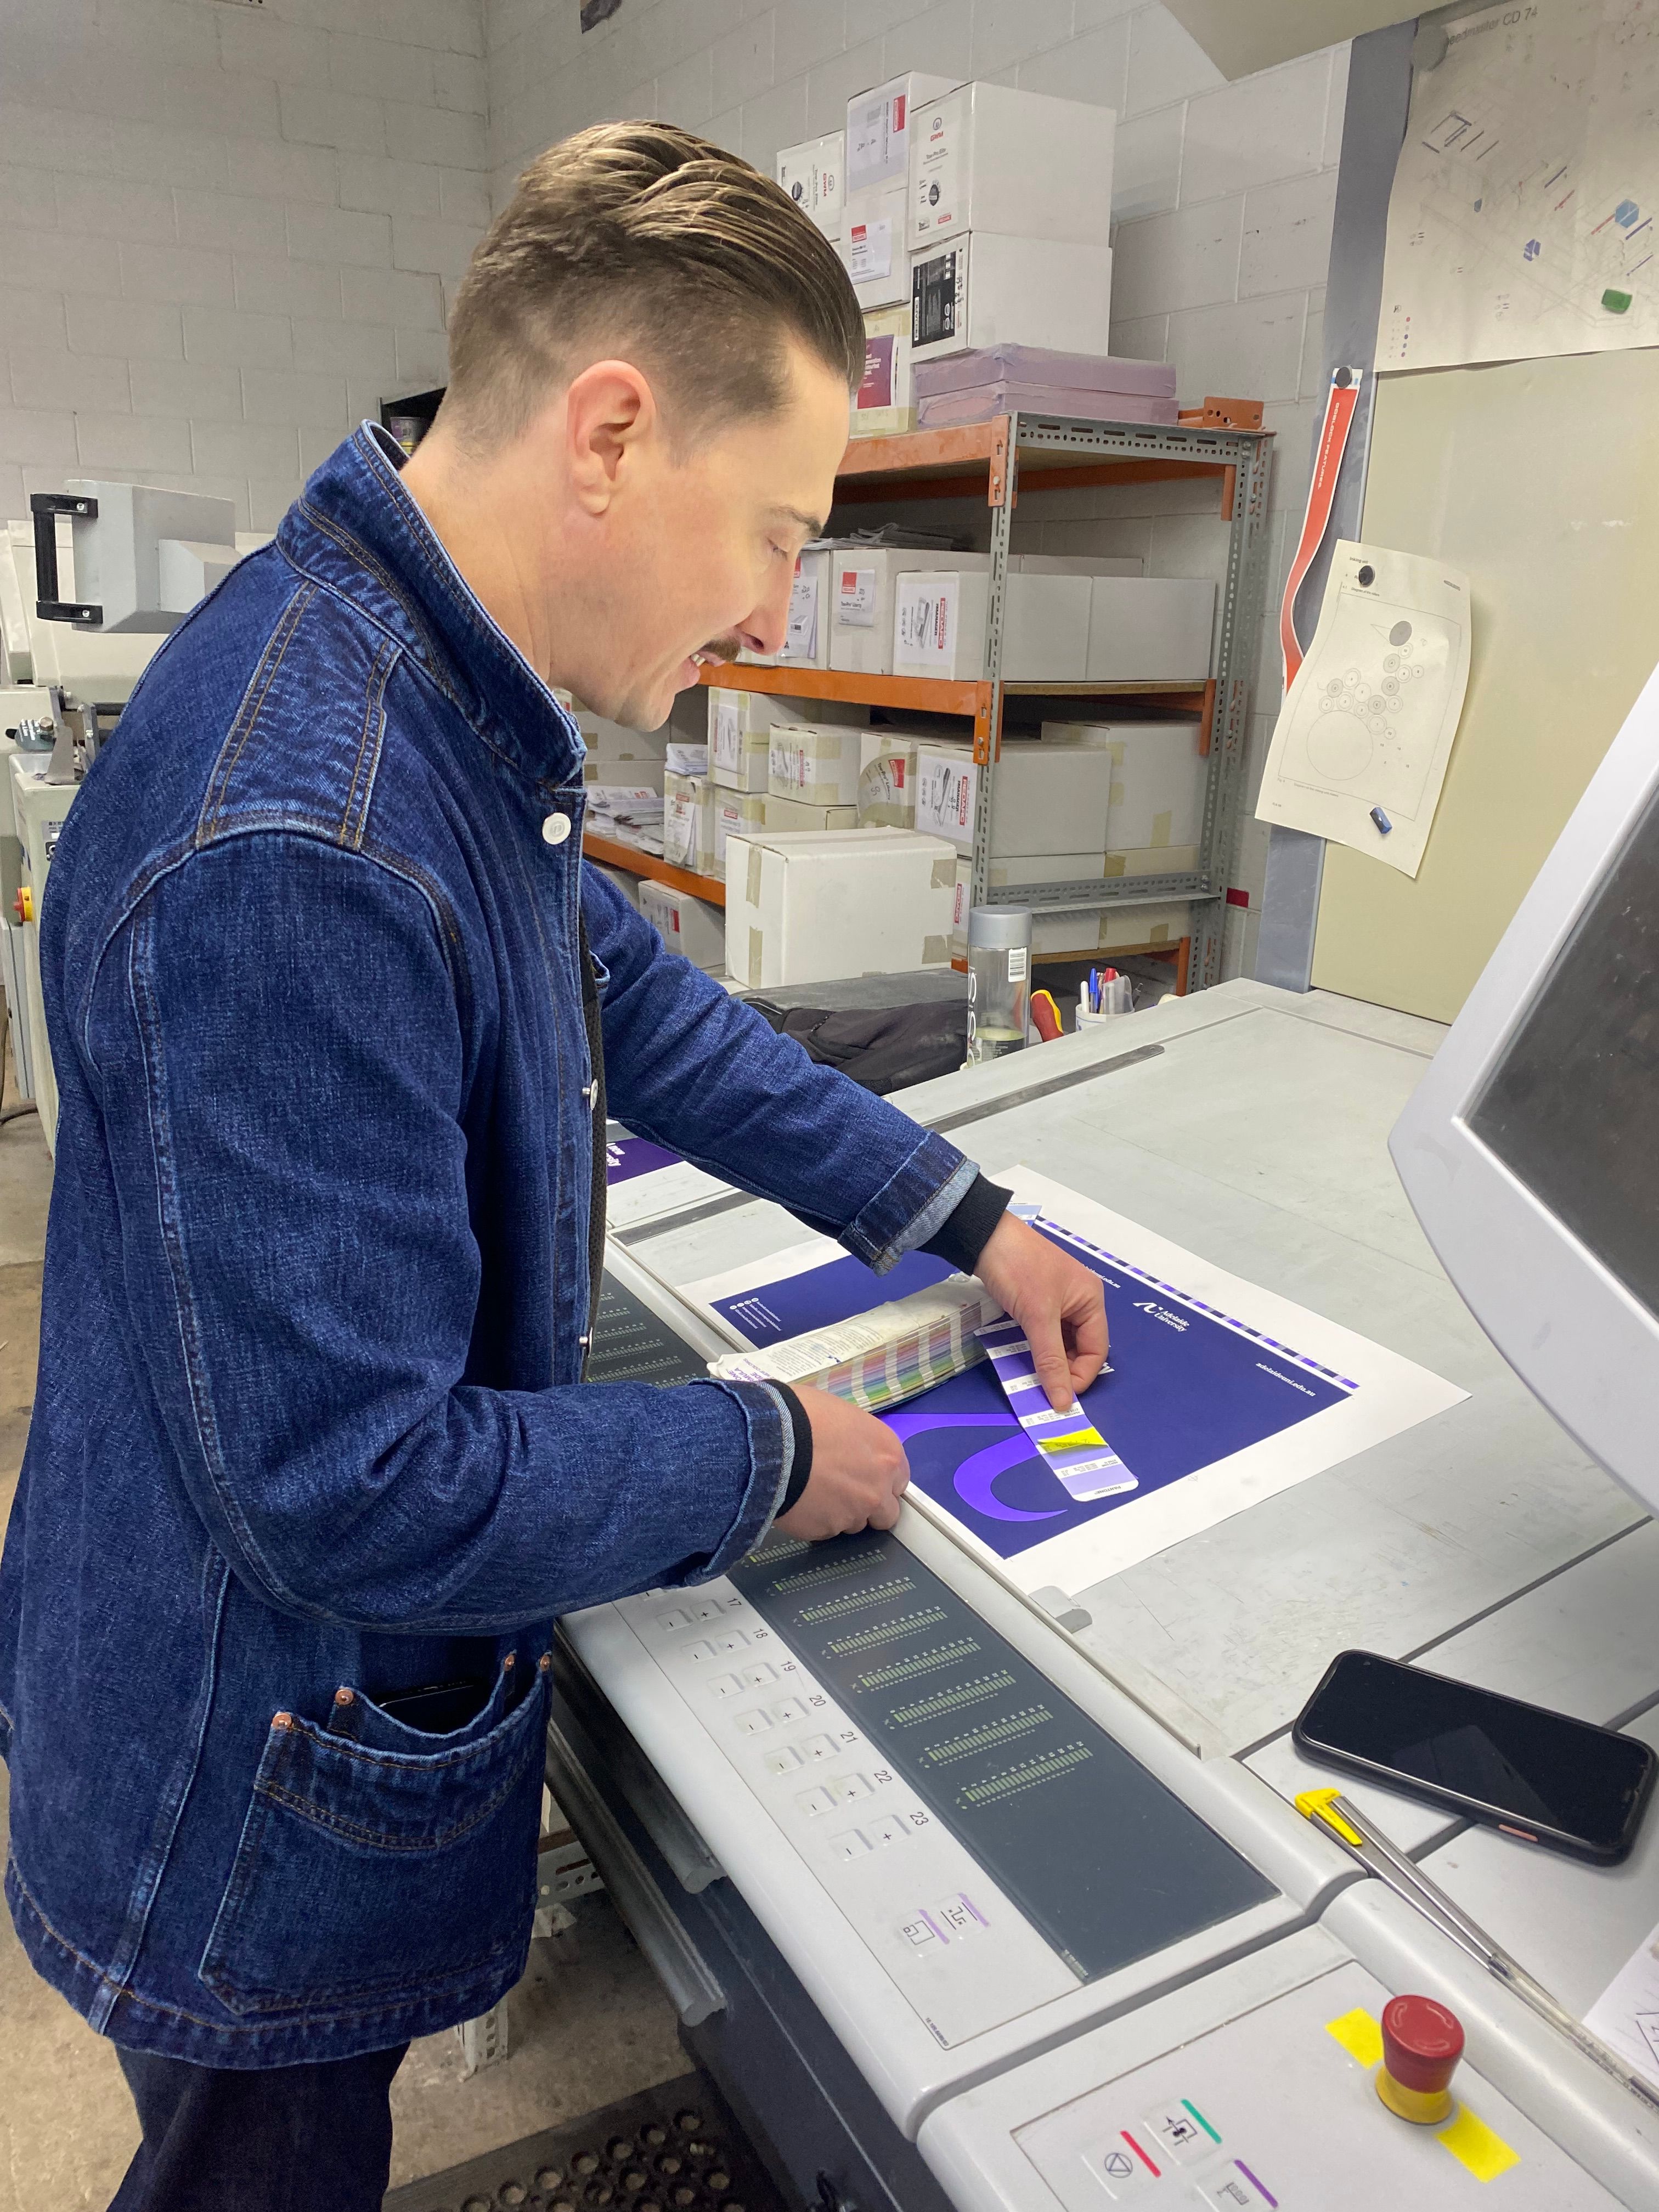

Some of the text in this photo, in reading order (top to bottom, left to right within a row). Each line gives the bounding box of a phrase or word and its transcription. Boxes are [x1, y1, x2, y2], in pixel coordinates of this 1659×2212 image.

[1503, 10, 1520, 25] CD
[1525, 6, 1538, 21] 74
[1154, 1312, 1187, 1332] University
[1161, 1310, 1190, 1327] Adelaide
[1256, 1363, 1316, 1397] adelaideuni.edu.au
[727, 1598, 742, 1606] 17
[753, 1628, 768, 1639] 18
[781, 1661, 796, 1672] 19
[809, 1695, 827, 1707] 20
[840, 1731, 859, 1743] 21
[873, 1770, 893, 1784] 22
[910, 1812, 929, 1826] 23
